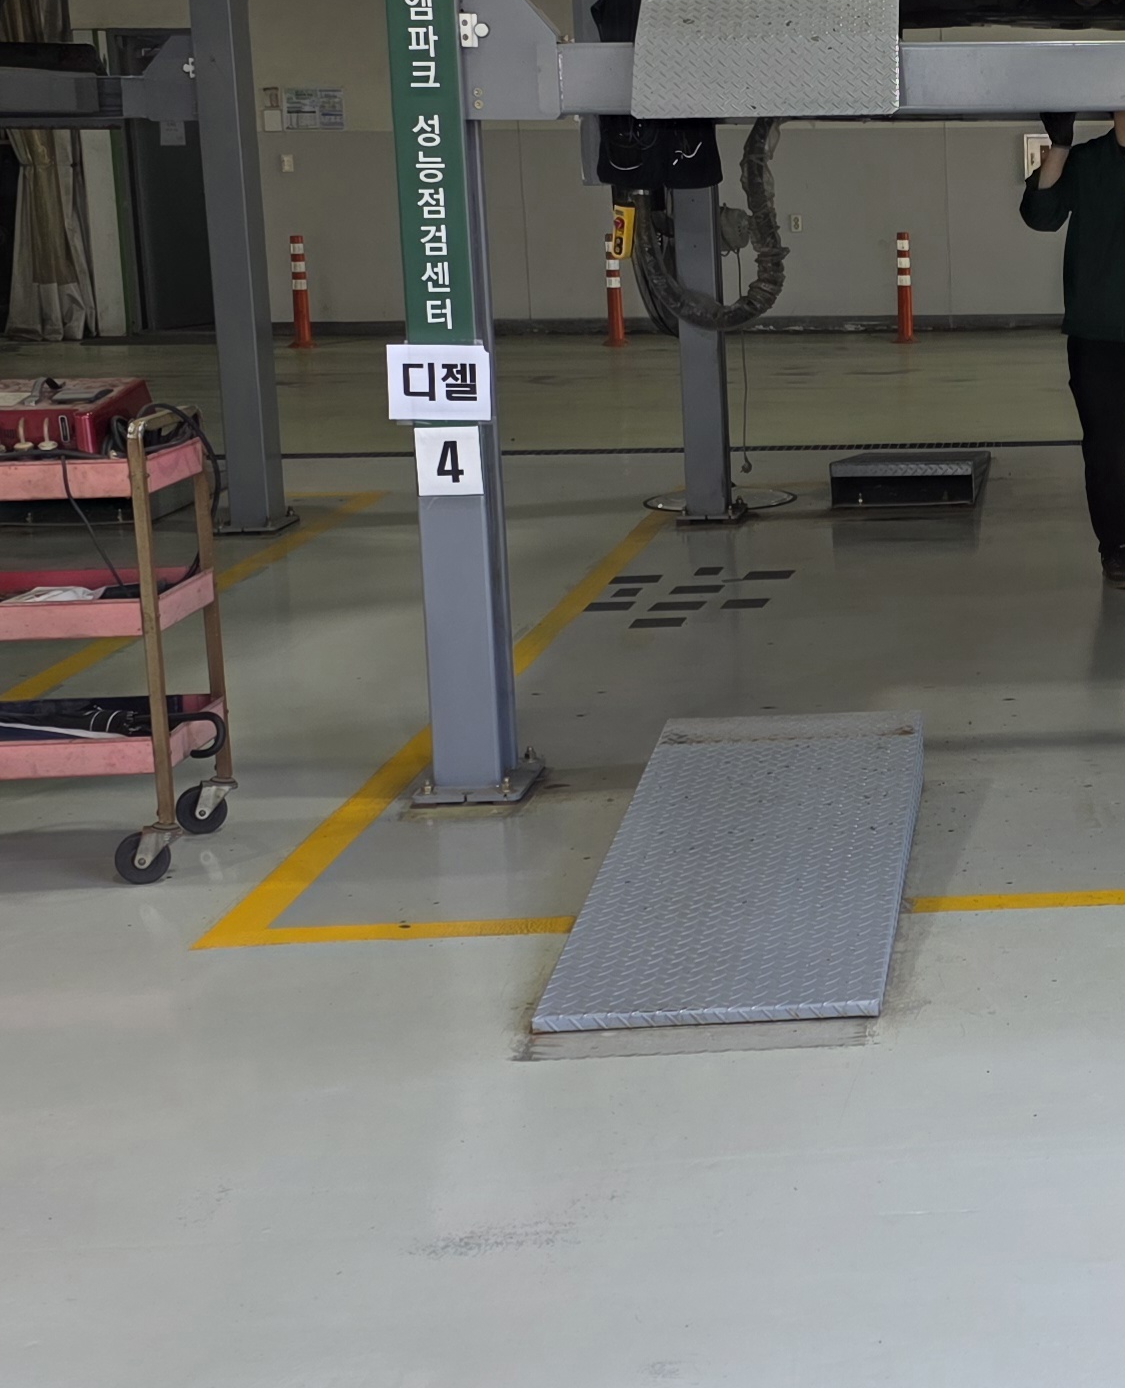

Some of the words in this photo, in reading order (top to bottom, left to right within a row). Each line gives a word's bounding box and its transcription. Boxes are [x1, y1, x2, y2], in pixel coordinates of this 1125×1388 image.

[412, 114, 453, 330] 성능점검센터
[402, 363, 479, 402] 디젤
[436, 440, 465, 484] 4
